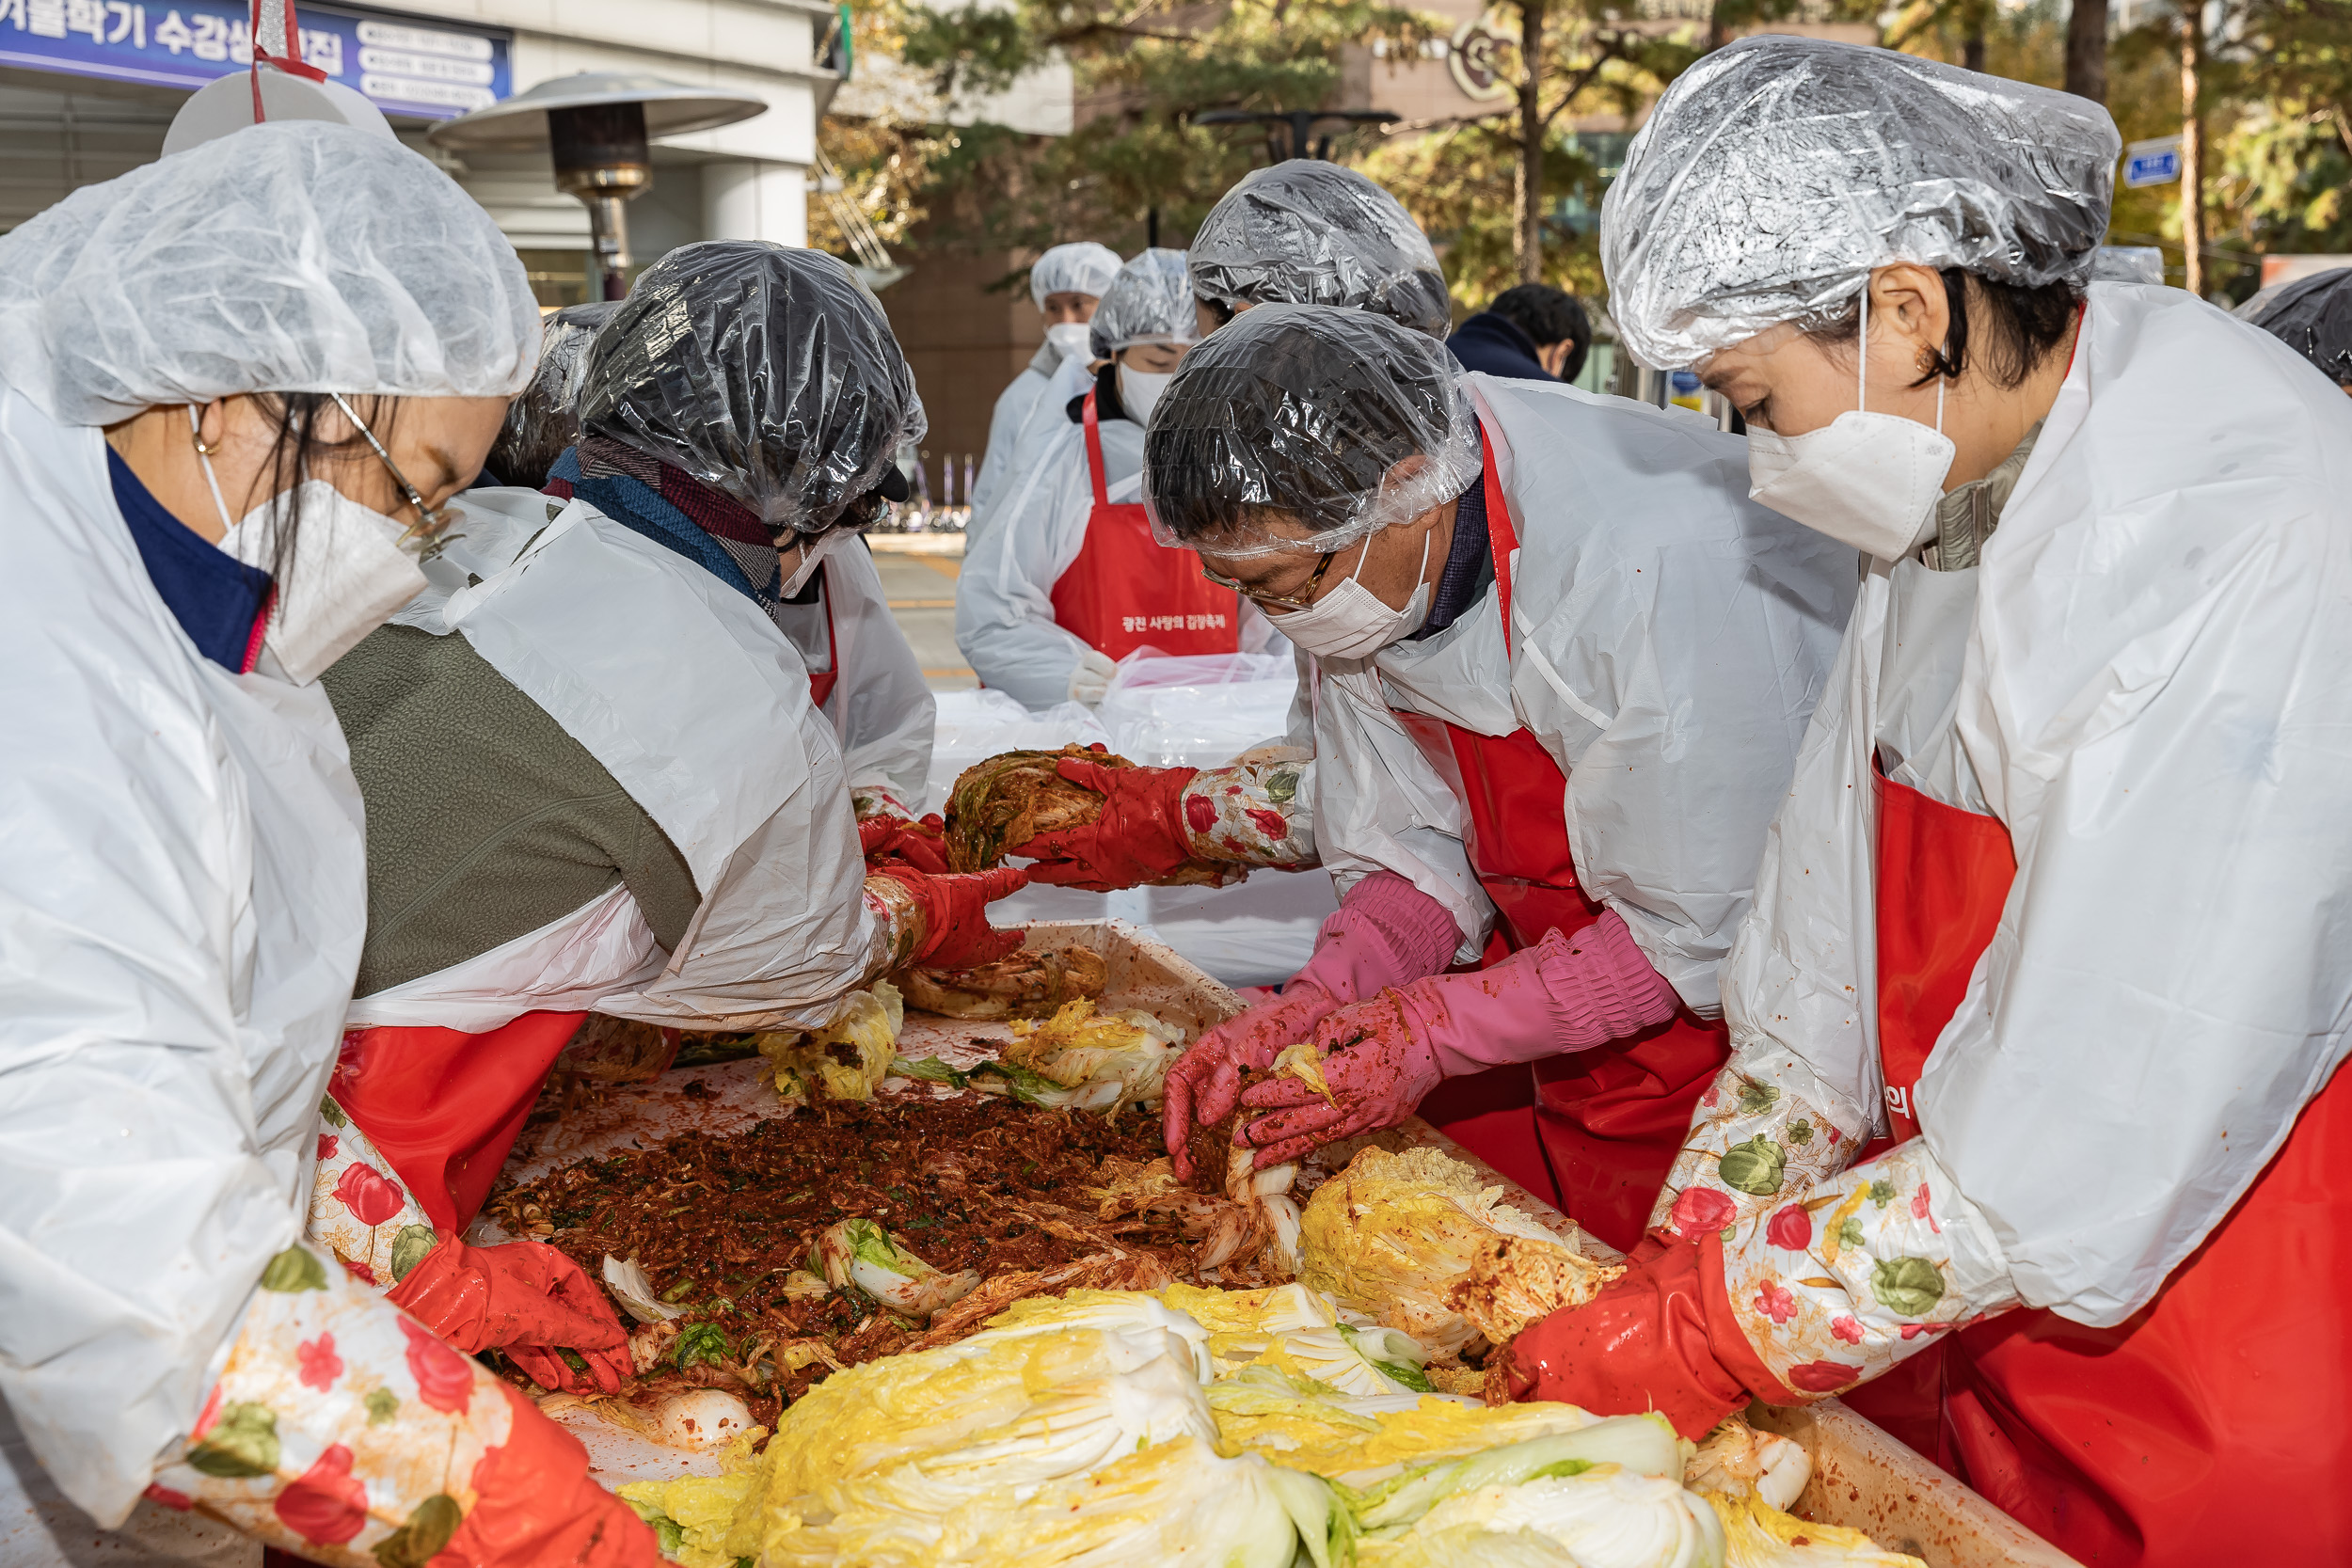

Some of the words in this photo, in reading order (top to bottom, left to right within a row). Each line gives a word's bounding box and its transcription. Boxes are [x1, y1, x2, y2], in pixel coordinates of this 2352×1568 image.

[298, 28, 344, 77] 집
[1122, 616, 1147, 633] 광진
[1149, 614, 1184, 632] 사랑의
[1185, 612, 1226, 631] 김장축제
